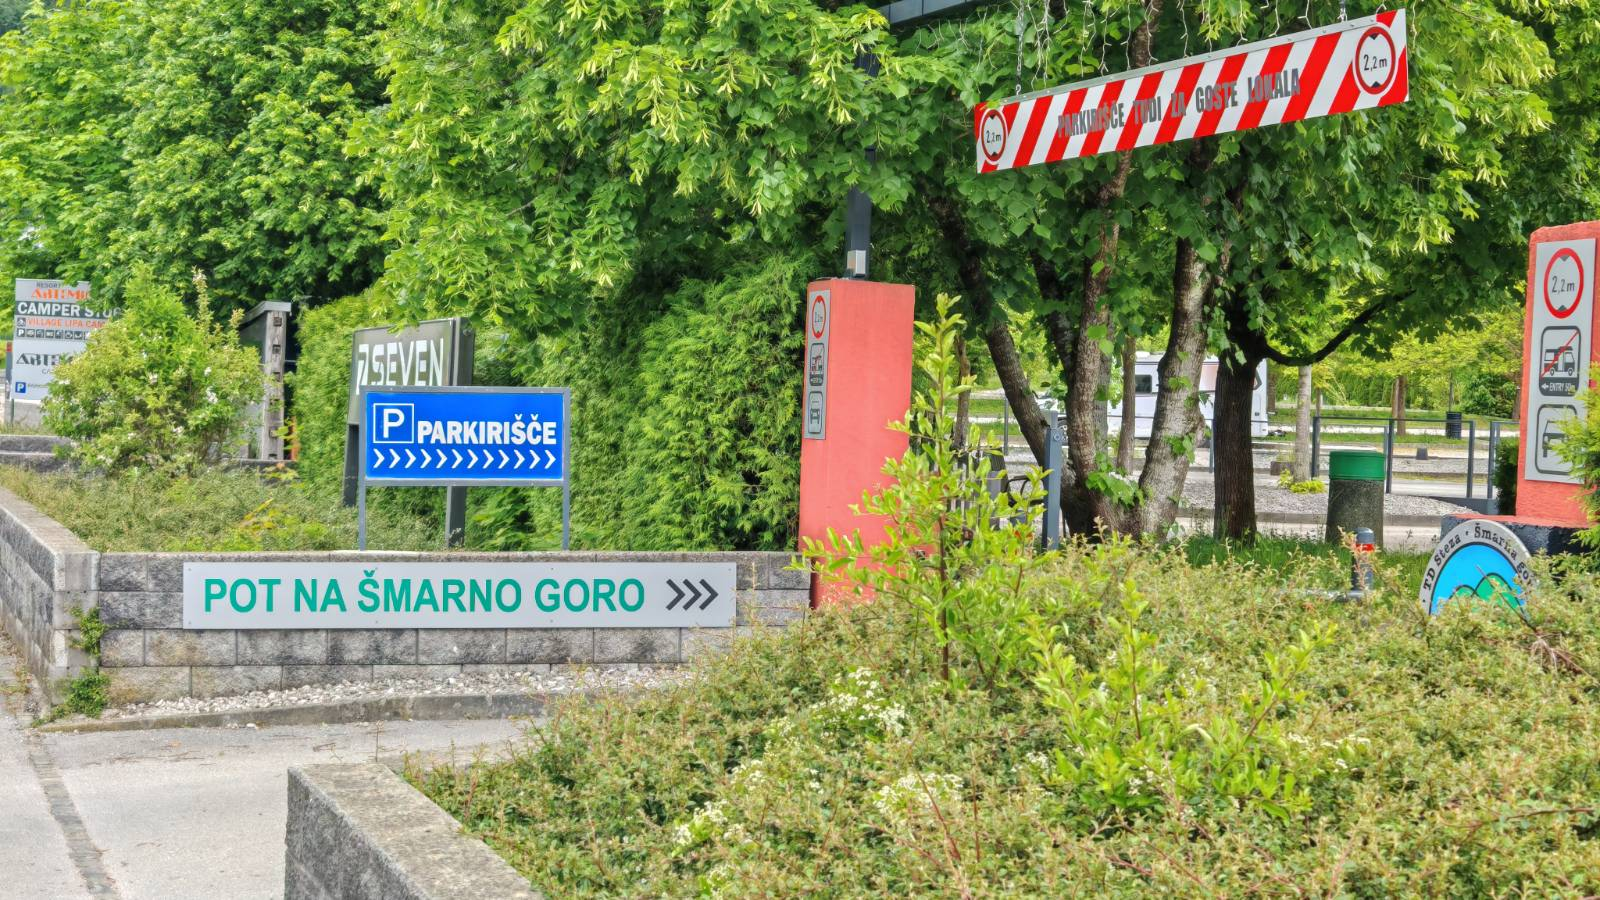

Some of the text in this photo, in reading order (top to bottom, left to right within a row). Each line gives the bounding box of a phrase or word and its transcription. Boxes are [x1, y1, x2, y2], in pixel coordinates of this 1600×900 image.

[1058, 68, 1301, 138] PARKIRIŠČE TUDI ZA GOSTE LOKALA
[18, 302, 80, 317] CAMPER
[28, 318, 61, 327] VILLAGE
[1550, 383, 1564, 392] ENTRY
[383, 408, 557, 445] P PARKIRIŠČE
[1424, 568, 1436, 591] TD
[1434, 534, 1461, 567] Steza
[1474, 523, 1517, 560] Šmarna
[205, 570, 645, 614] POT NA ŠMARNO GORO
